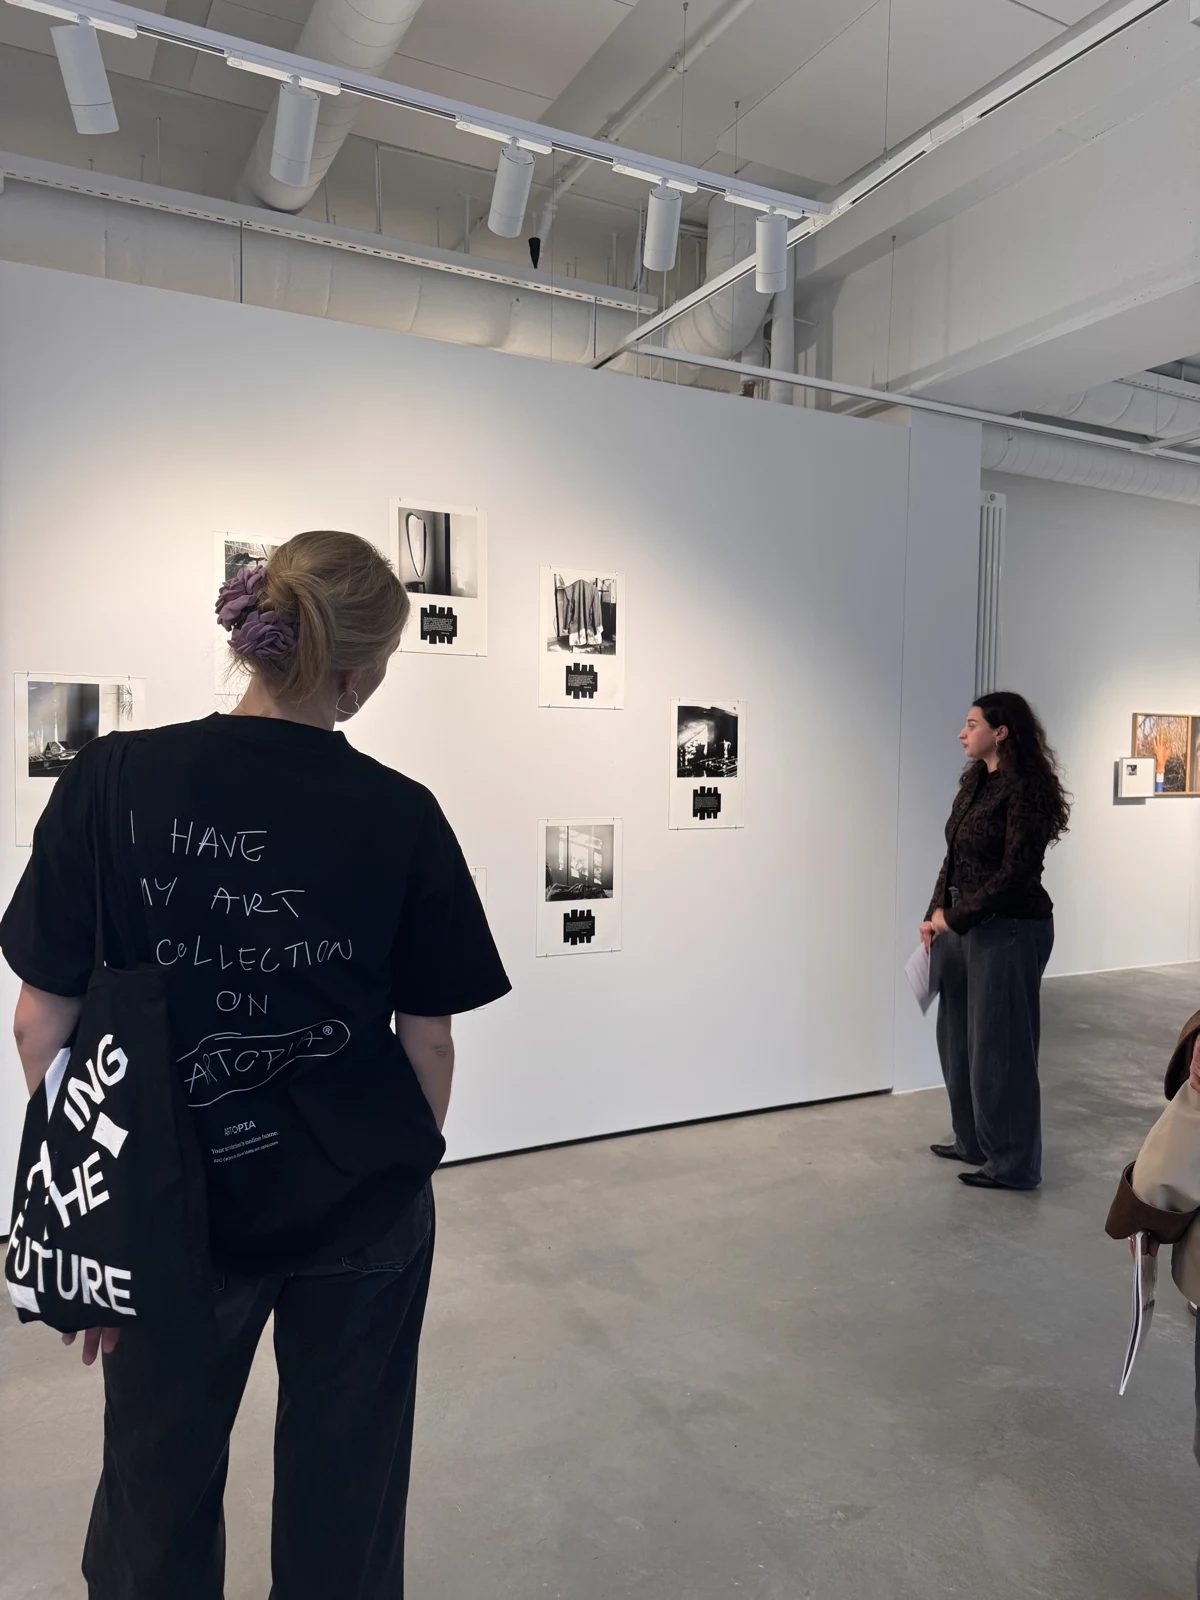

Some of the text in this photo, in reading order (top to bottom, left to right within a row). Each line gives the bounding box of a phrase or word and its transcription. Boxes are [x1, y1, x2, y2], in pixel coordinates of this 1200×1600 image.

[130, 809, 267, 862] I HAVE
[210, 887, 305, 918] ART
[156, 935, 352, 972] COLLECTION
[216, 990, 267, 1016] ON
[44, 1150, 110, 1236] HE
